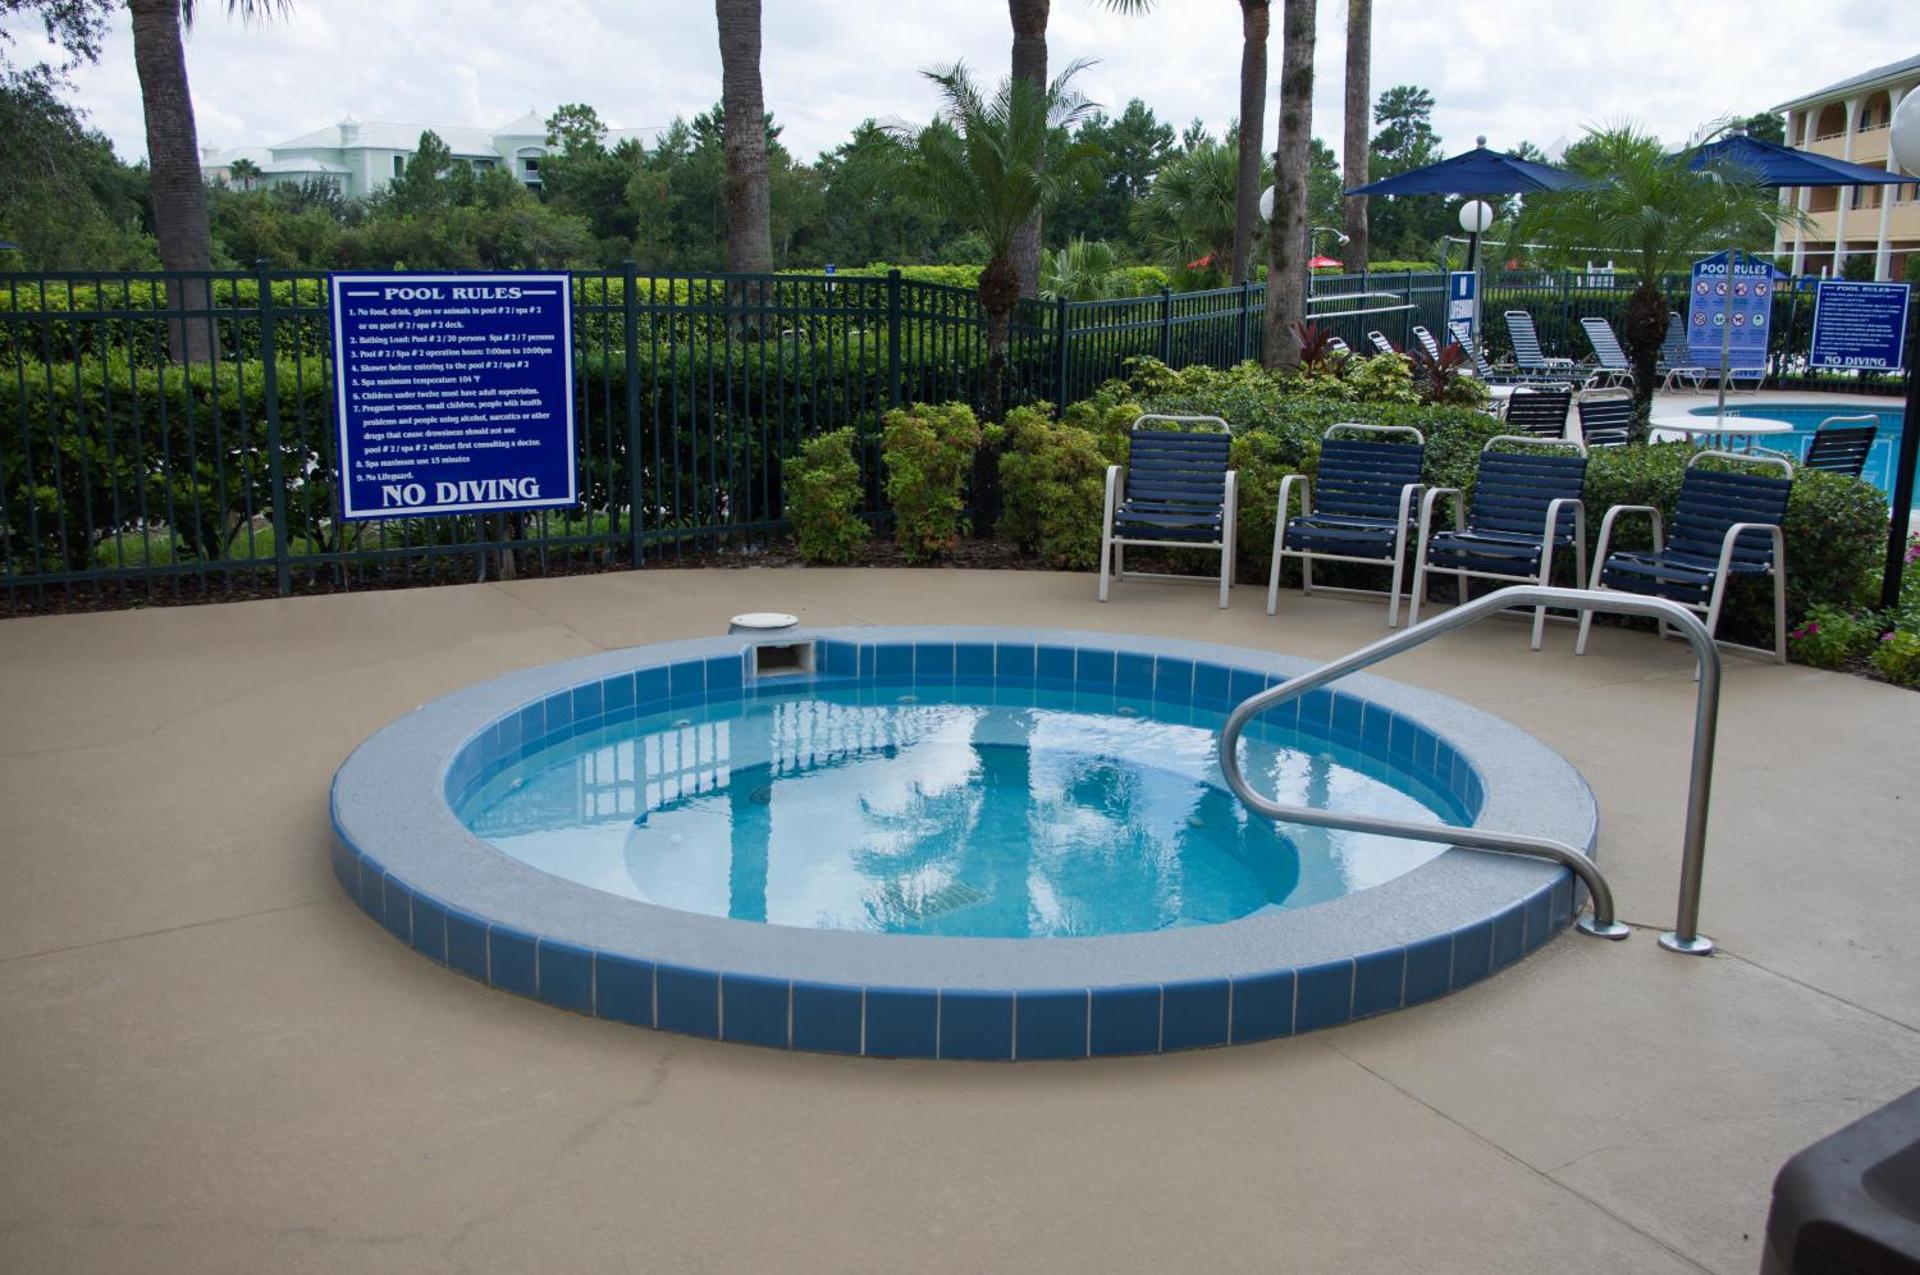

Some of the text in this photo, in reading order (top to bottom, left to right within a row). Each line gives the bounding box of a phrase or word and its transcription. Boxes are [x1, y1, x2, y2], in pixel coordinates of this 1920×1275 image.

[1700, 264, 1766, 274] POO RULES
[384, 287, 522, 300] POOL RULES
[413, 308, 432, 317] glass
[481, 307, 497, 316] pool
[380, 322, 396, 331] pool
[359, 336, 388, 346] Bathing
[489, 334, 502, 343] Spa
[396, 350, 410, 359] Spa
[426, 349, 460, 358] operation
[1824, 356, 1886, 366] NO DIVING
[414, 363, 444, 372] entering
[468, 362, 484, 370] pool
[361, 378, 375, 387] Spa
[413, 376, 457, 386] temperature
[363, 405, 395, 414] Pregnant
[478, 401, 502, 410] people
[363, 418, 397, 428] problems
[414, 416, 438, 426] people
[439, 416, 459, 425] using
[364, 432, 385, 441] drugs
[425, 429, 464, 437] drowsiness
[365, 446, 381, 455] pool
[473, 440, 510, 450] consulting
[365, 460, 379, 469] Spa
[381, 458, 415, 466] maximum
[382, 477, 540, 507] NO DIVING
